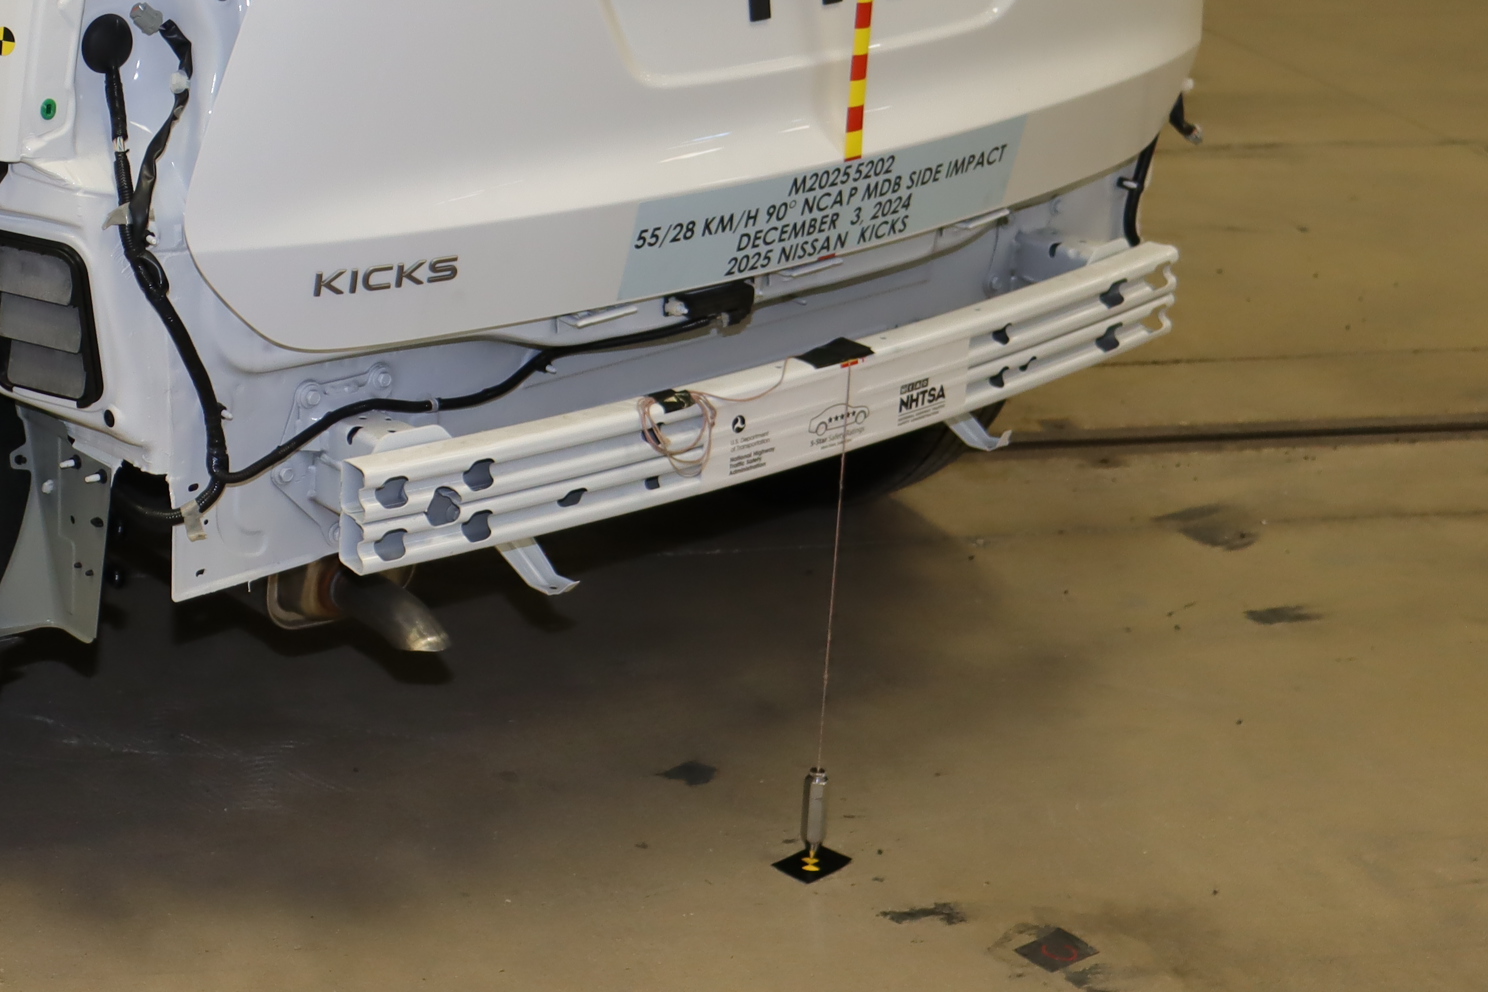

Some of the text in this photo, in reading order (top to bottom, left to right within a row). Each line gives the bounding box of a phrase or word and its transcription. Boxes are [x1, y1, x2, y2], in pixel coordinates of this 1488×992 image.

[634, 220, 696, 250] 55/28
[702, 208, 760, 237] KM/H
[801, 186, 858, 216] NCAP
[861, 175, 902, 202] MDB
[906, 164, 943, 190] SIDE
[945, 144, 1008, 178] IMPACT
[788, 155, 896, 196] M20255202
[724, 215, 910, 276] 2025 NISSAN KICKS
[736, 193, 912, 252] DECEMBER 3, 2024
[313, 254, 459, 297] KICKS
[899, 384, 945, 413] NHTSA
